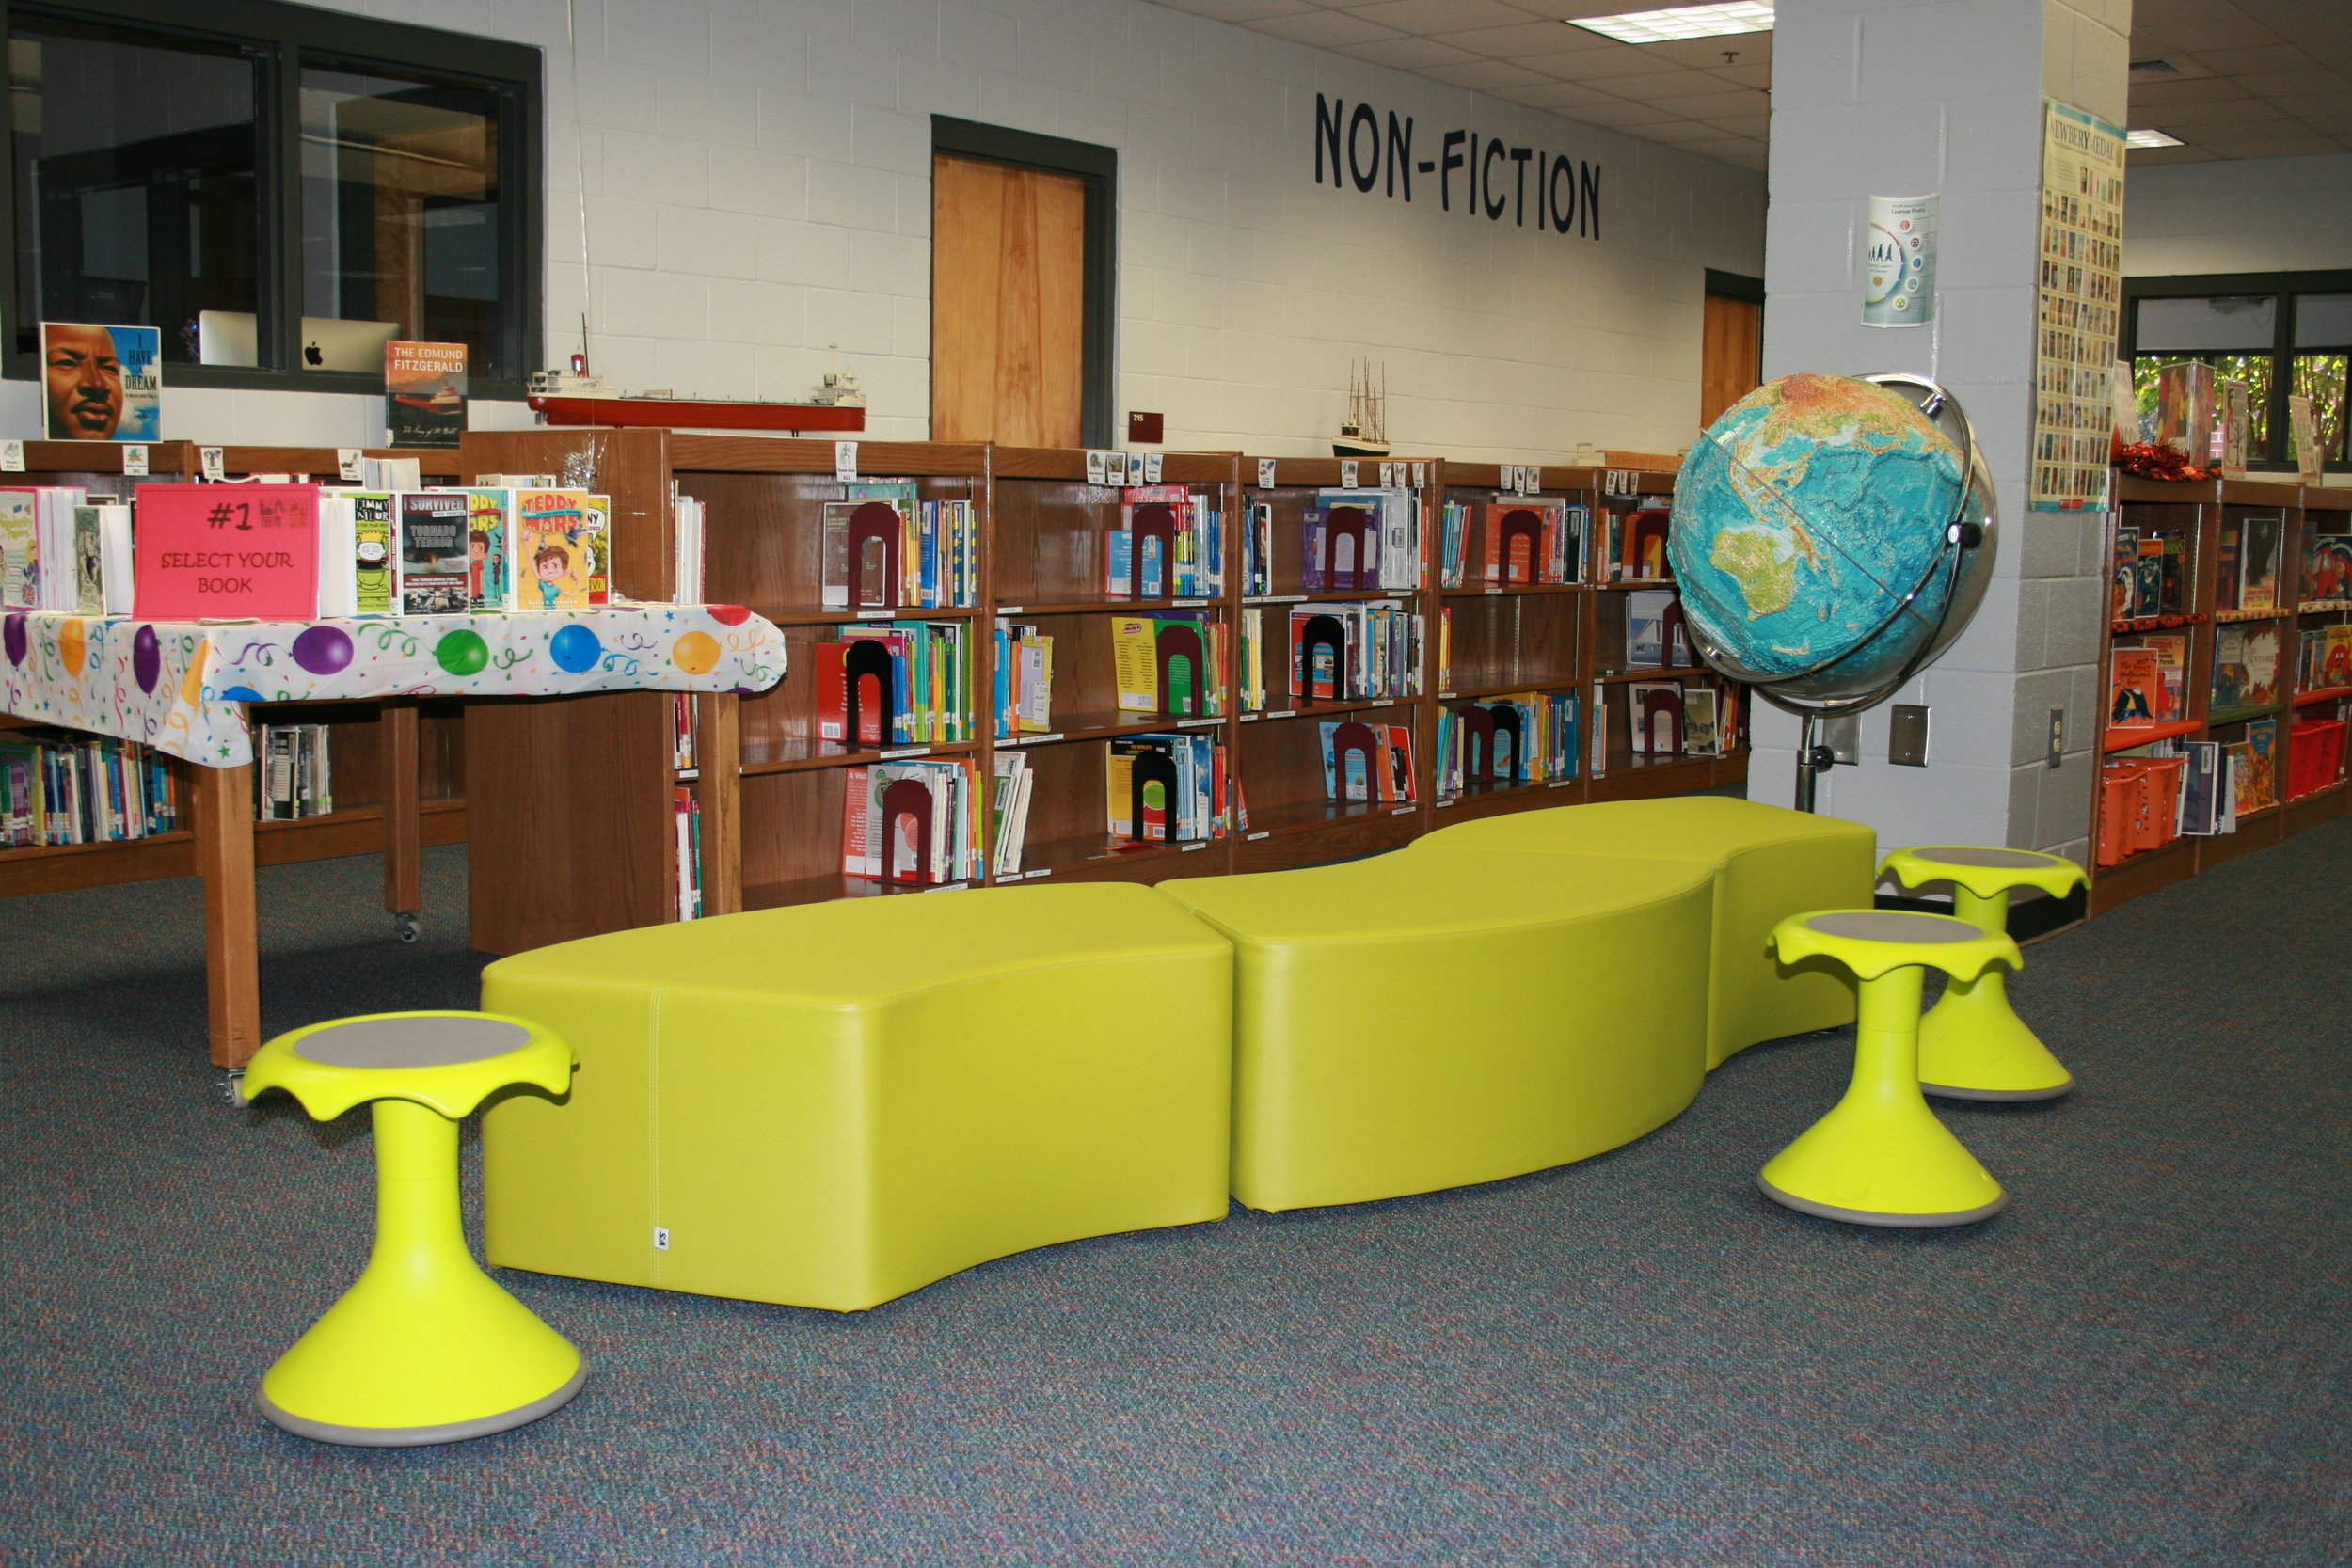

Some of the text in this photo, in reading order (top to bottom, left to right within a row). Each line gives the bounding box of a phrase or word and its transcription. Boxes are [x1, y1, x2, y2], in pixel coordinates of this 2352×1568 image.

[2049, 119, 2090, 150] NEWBERY
[2090, 137, 2115, 161] MEDAL
[1315, 92, 1601, 241] NON-FICTION
[137, 333, 143, 349] I
[129, 350, 152, 366] HAVE
[394, 347, 463, 359] THE EDMUND
[138, 366, 144, 374] A
[394, 359, 463, 372] FITZGERALD
[125, 375, 157, 391] DREAM
[1133, 414, 1144, 422] 215
[411, 498, 464, 511] SURVIVED
[470, 493, 498, 510] DDY
[525, 494, 579, 512] TEDDY
[207, 502, 253, 531] #1
[410, 525, 457, 537] TORNADO
[524, 517, 580, 534] MARS
[414, 536, 453, 547] TERROR
[161, 552, 294, 570] SELECT YOUR
[197, 577, 253, 594] BOOK
